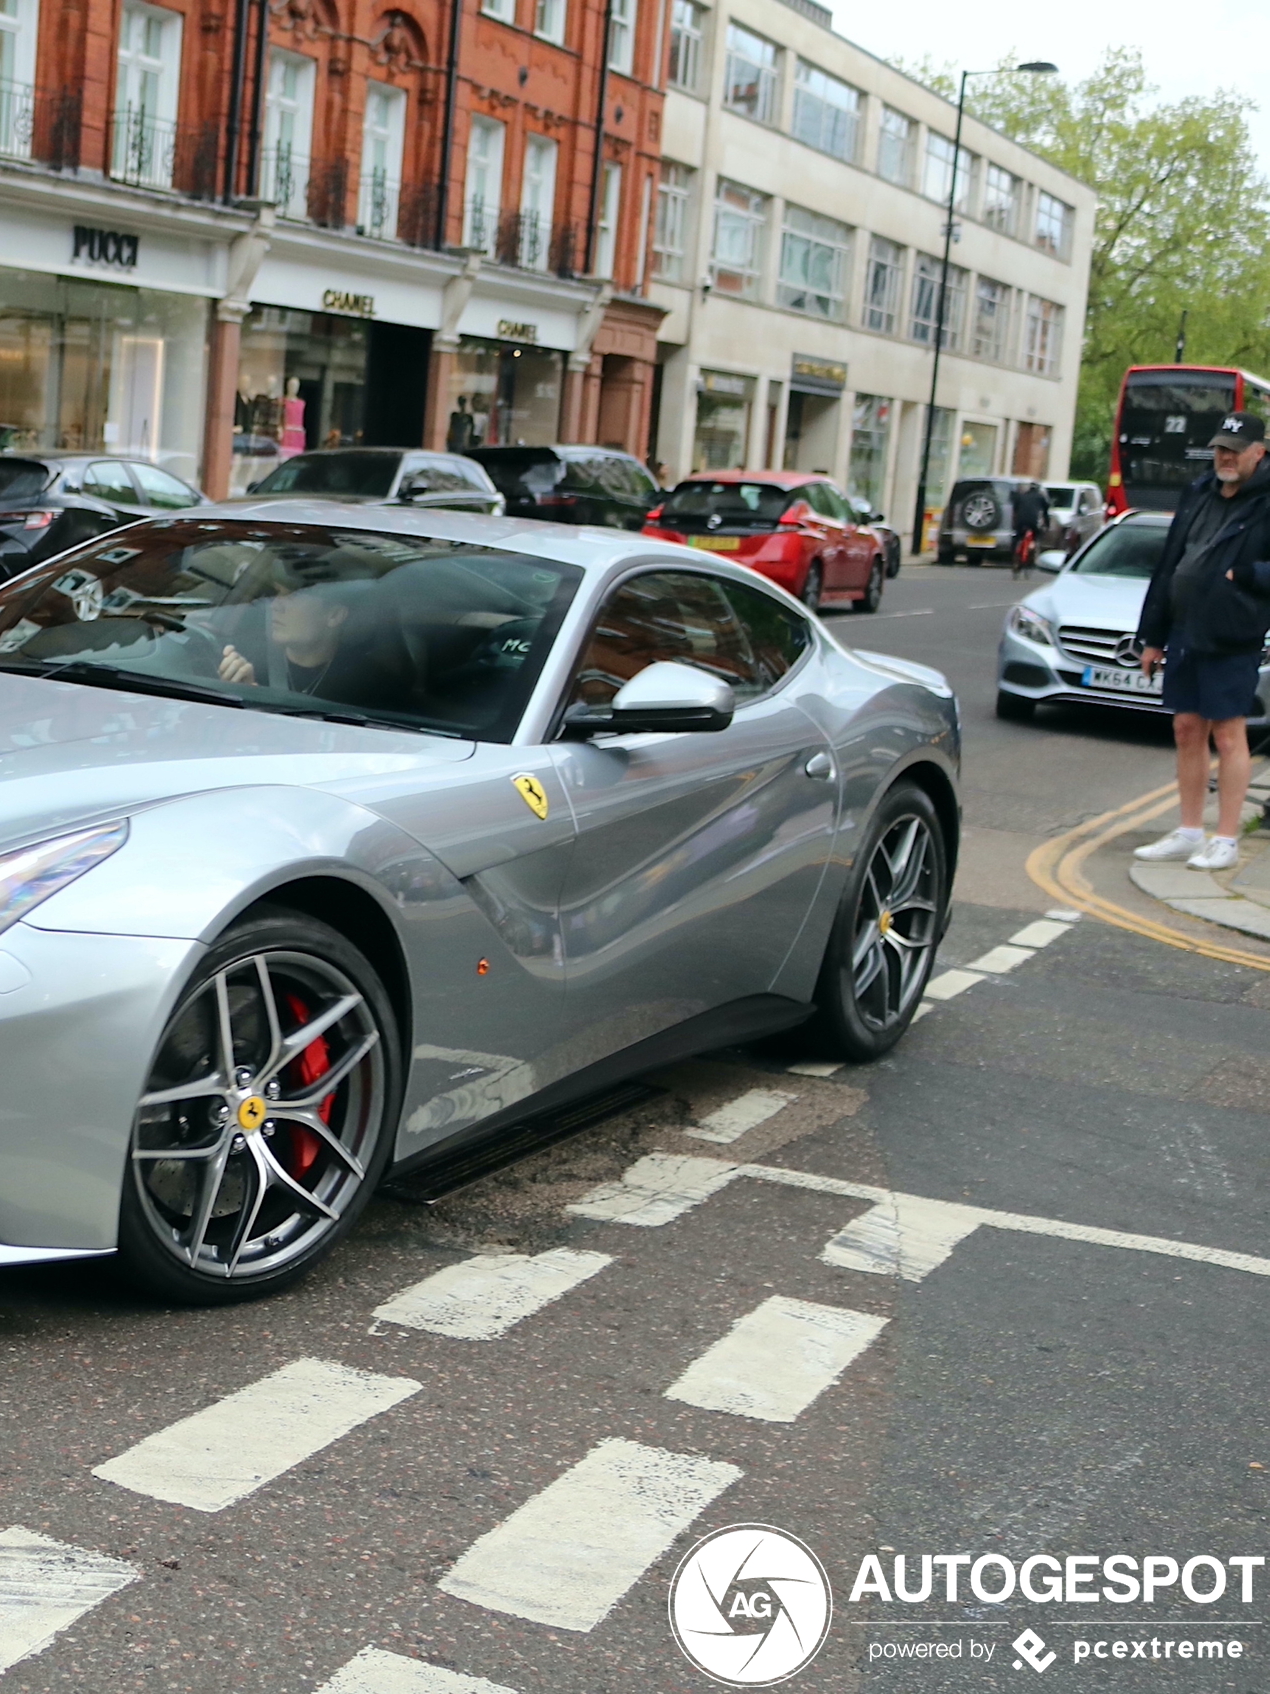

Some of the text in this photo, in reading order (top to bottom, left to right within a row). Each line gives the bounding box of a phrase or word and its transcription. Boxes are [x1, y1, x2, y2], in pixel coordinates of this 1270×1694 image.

[73, 225, 139, 267] PUCCI
[322, 289, 377, 315] CHANEL
[496, 319, 540, 342] CHANEL
[1164, 416, 1187, 433] 22
[1222, 417, 1243, 433] NY
